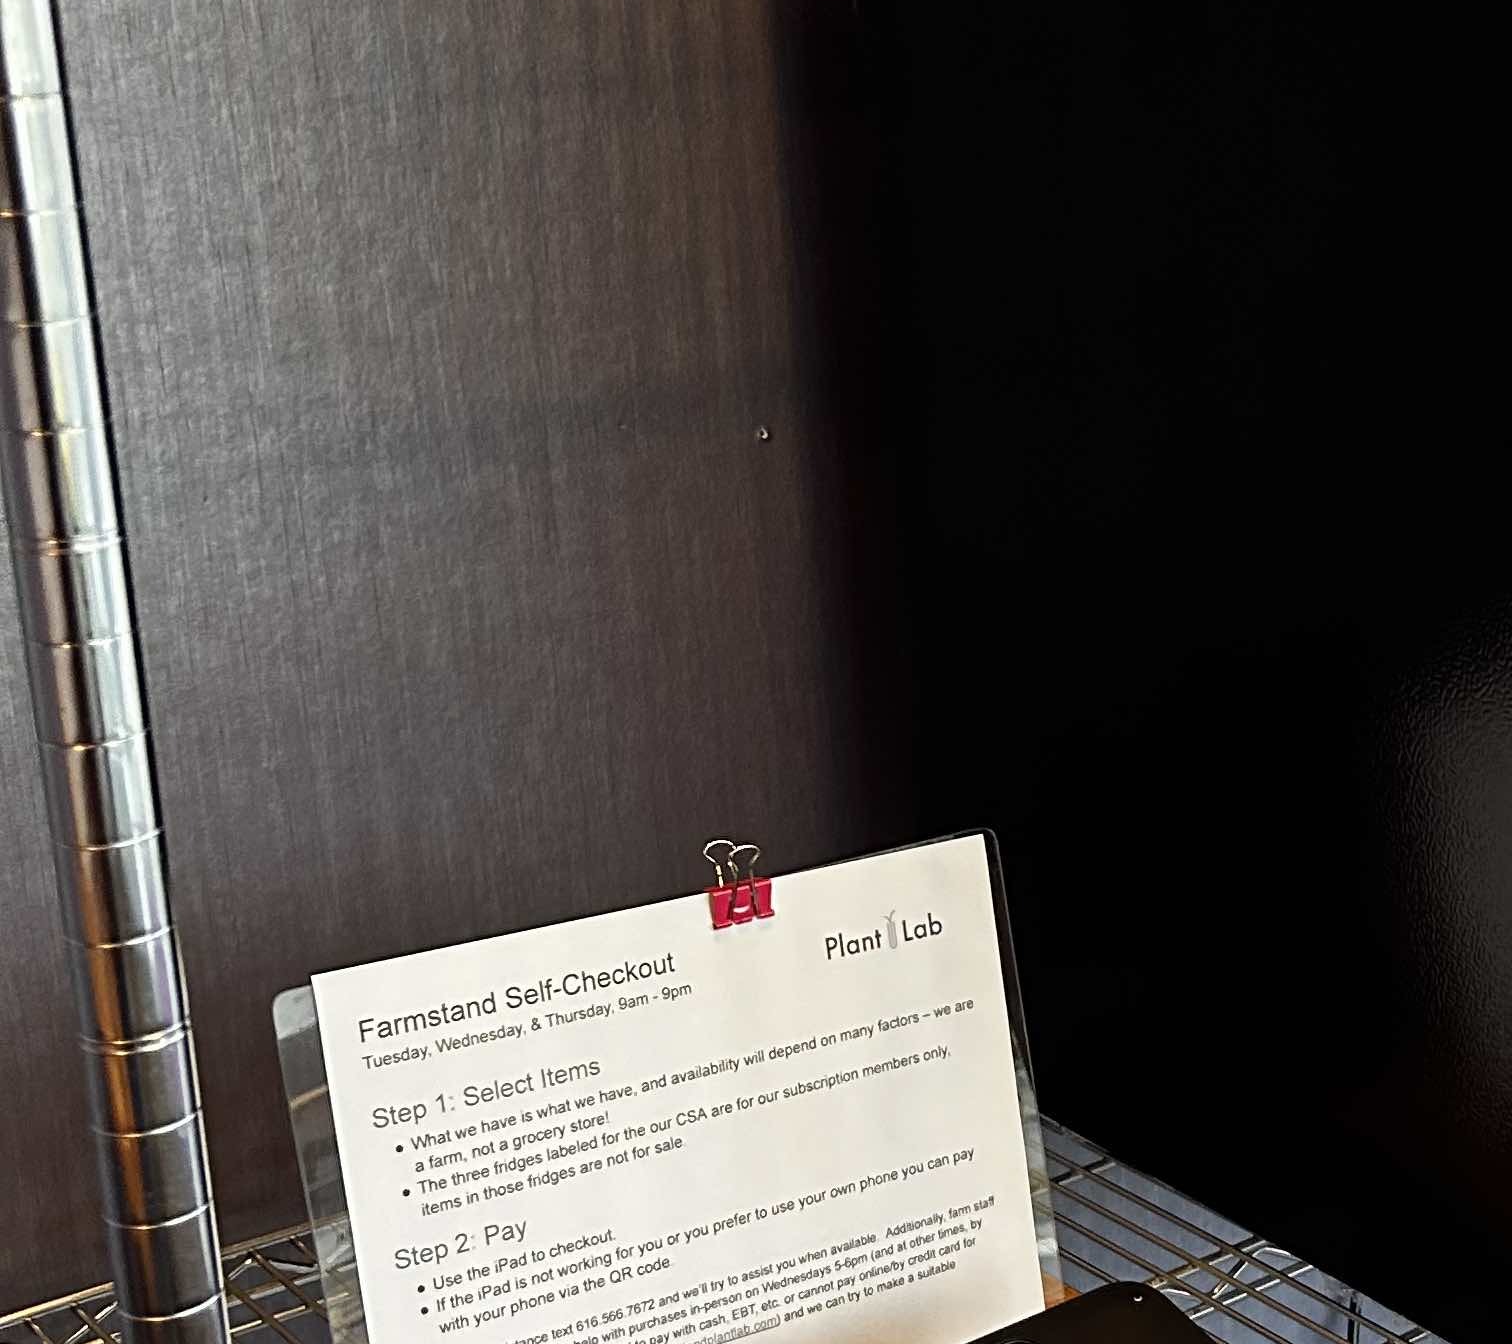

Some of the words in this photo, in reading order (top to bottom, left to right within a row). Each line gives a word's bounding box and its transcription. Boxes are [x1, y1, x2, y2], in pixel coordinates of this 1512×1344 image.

[824, 928, 881, 960] Plant
[901, 912, 942, 941] Lab
[358, 991, 496, 1043] Farmstand
[505, 952, 675, 1008] Self-Checkout
[361, 1045, 431, 1069] Tuesday,
[434, 1023, 526, 1053] Wednesday,
[530, 1017, 542, 1031] &
[544, 1003, 614, 1027] Thursday,
[617, 994, 648, 1010] 9am
[661, 984, 692, 1001] 9pm
[372, 1103, 427, 1128] Step
[435, 1093, 454, 1113] 1:
[463, 1072, 534, 1106] Select
[540, 1060, 600, 1088] Items
[409, 1129, 452, 1150] What
[454, 1125, 477, 1139] we
[480, 1115, 517, 1133] have
[519, 1110, 533, 1123] is
[535, 1098, 571, 1119] what
[573, 1095, 595, 1109] we
[598, 1085, 637, 1103] have,
[640, 1073, 667, 1092] and
[670, 1057, 739, 1084] availability
[742, 1049, 765, 1066] will
[768, 1035, 816, 1060] depend
[820, 1034, 836, 1047] on
[839, 1024, 874, 1042] many
[877, 1013, 919, 1032] factors
[932, 1005, 951, 1018] we
[954, 999, 973, 1012] are
[415, 1161, 424, 1172] a
[428, 1151, 467, 1168] farm,
[471, 1140, 495, 1158] not
[499, 1139, 508, 1151] a
[512, 1124, 565, 1150] grocery
[569, 1110, 609, 1132] store!
[416, 1178, 447, 1194] The
[450, 1167, 489, 1186] three
[493, 1153, 543, 1175] fridges
[545, 1135, 598, 1161] labeled
[600, 1132, 620, 1146] for
[623, 1126, 645, 1140] the
[649, 1118, 672, 1133] our
[675, 1107, 707, 1126] CSA
[711, 1103, 732, 1117] are
[735, 1096, 754, 1110] for
[757, 1090, 779, 1105] our
[782, 1069, 859, 1098] subscription
[861, 1053, 920, 1077] members
[420, 1196, 462, 1216] items
[465, 1191, 479, 1204] in
[482, 1180, 524, 1200] those
[526, 1166, 576, 1188] fridges
[579, 1159, 602, 1174] are
[606, 1149, 629, 1167] not
[631, 1145, 650, 1160] for
[394, 1243, 448, 1269] Step
[454, 1232, 475, 1254] 2:
[483, 1220, 526, 1246] Pay
[432, 1273, 462, 1289] Use
[466, 1266, 490, 1281] the
[494, 1251, 527, 1273] iPad
[531, 1250, 545, 1263] to
[548, 1228, 616, 1257] checkout.
[436, 1296, 445, 1312] If
[449, 1293, 473, 1308] the
[477, 1279, 511, 1300] iPad
[514, 1276, 527, 1289] is
[531, 1267, 554, 1285] not
[556, 1253, 612, 1277] working
[615, 1246, 634, 1260] for
[637, 1238, 663, 1257] you
[666, 1232, 680, 1245] or
[683, 1224, 709, 1244] you
[712, 1212, 751, 1235] prefer
[754, 1207, 767, 1220] to
[771, 1200, 795, 1215] use
[797, 1190, 826, 1210] your
[829, 1182, 856, 1198] own
[859, 1170, 898, 1192] phone
[900, 1162, 924, 1180] you
[927, 1155, 949, 1170] can
[952, 1147, 974, 1165] pay
[438, 1314, 469, 1333] with
[472, 1305, 506, 1327] your
[509, 1291, 555, 1317] phone
[558, 1285, 579, 1299] via
[582, 1277, 605, 1292] the
[609, 1266, 633, 1283] QR
[551, 1323, 574, 1339] text
[658, 1290, 679, 1307] and
[681, 1281, 708, 1299] we'll
[710, 1279, 724, 1291] try
[726, 1275, 738, 1286] to
[741, 1263, 773, 1282] assist
[775, 1257, 796, 1273] you
[797, 1248, 827, 1264] when
[948, 1204, 971, 1219] farm
[973, 1194, 994, 1212] staff
